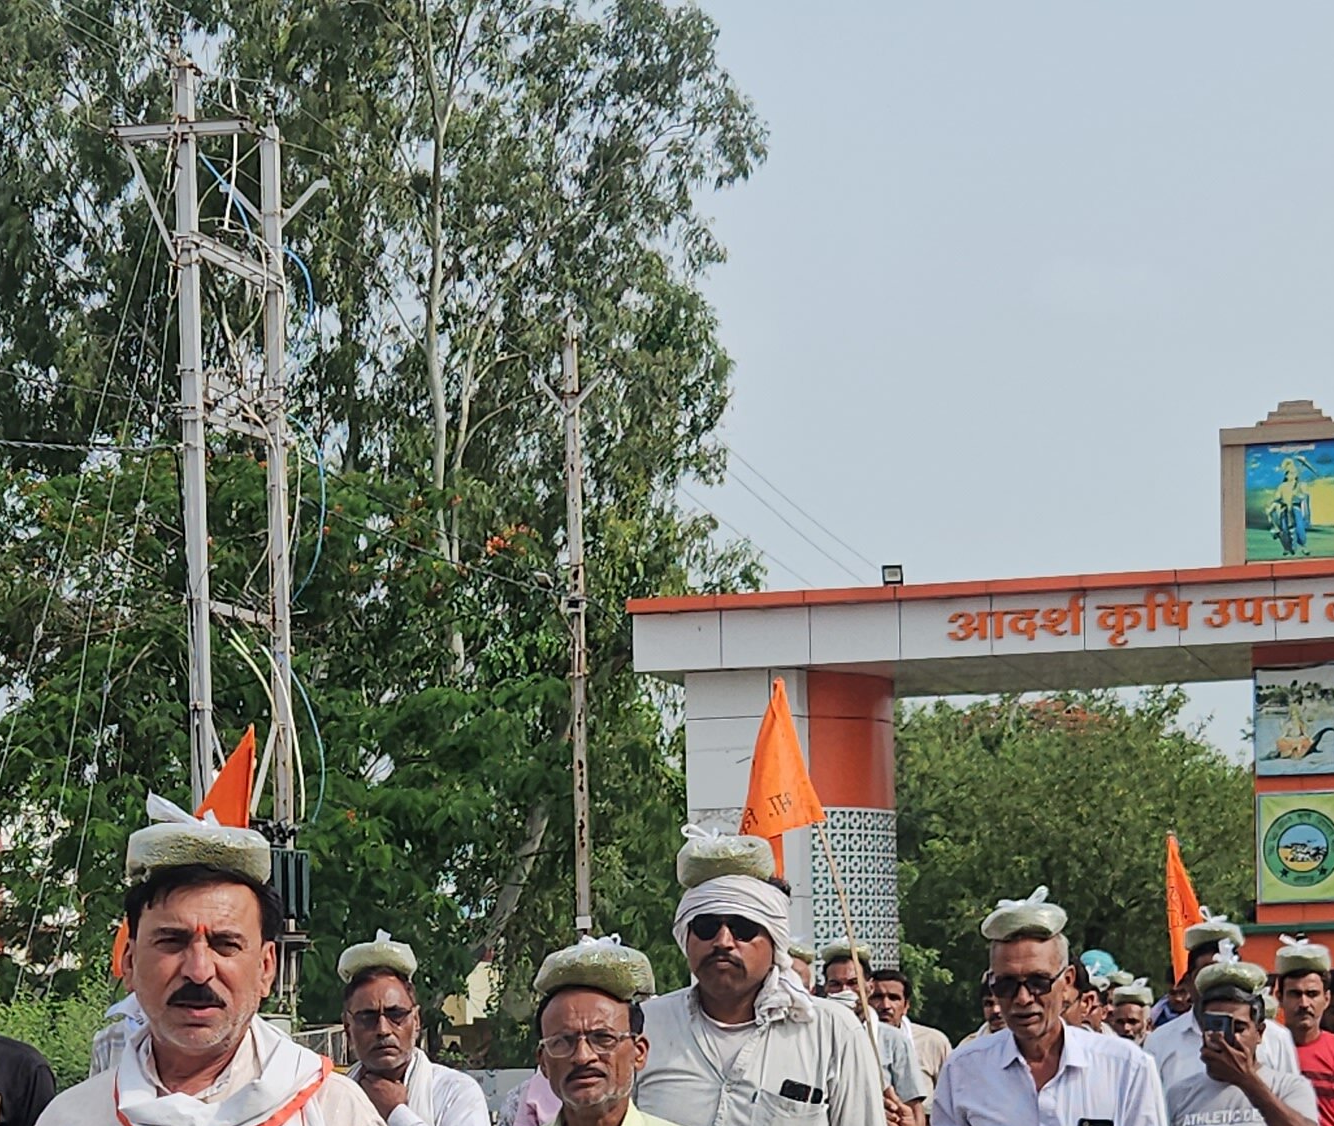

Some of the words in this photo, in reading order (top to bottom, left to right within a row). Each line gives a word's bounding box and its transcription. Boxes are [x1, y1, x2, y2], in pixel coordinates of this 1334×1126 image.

[948, 592, 1085, 641] आदर्श
[1096, 587, 1192, 647] कृषि
[1202, 594, 1315, 628] उपज
